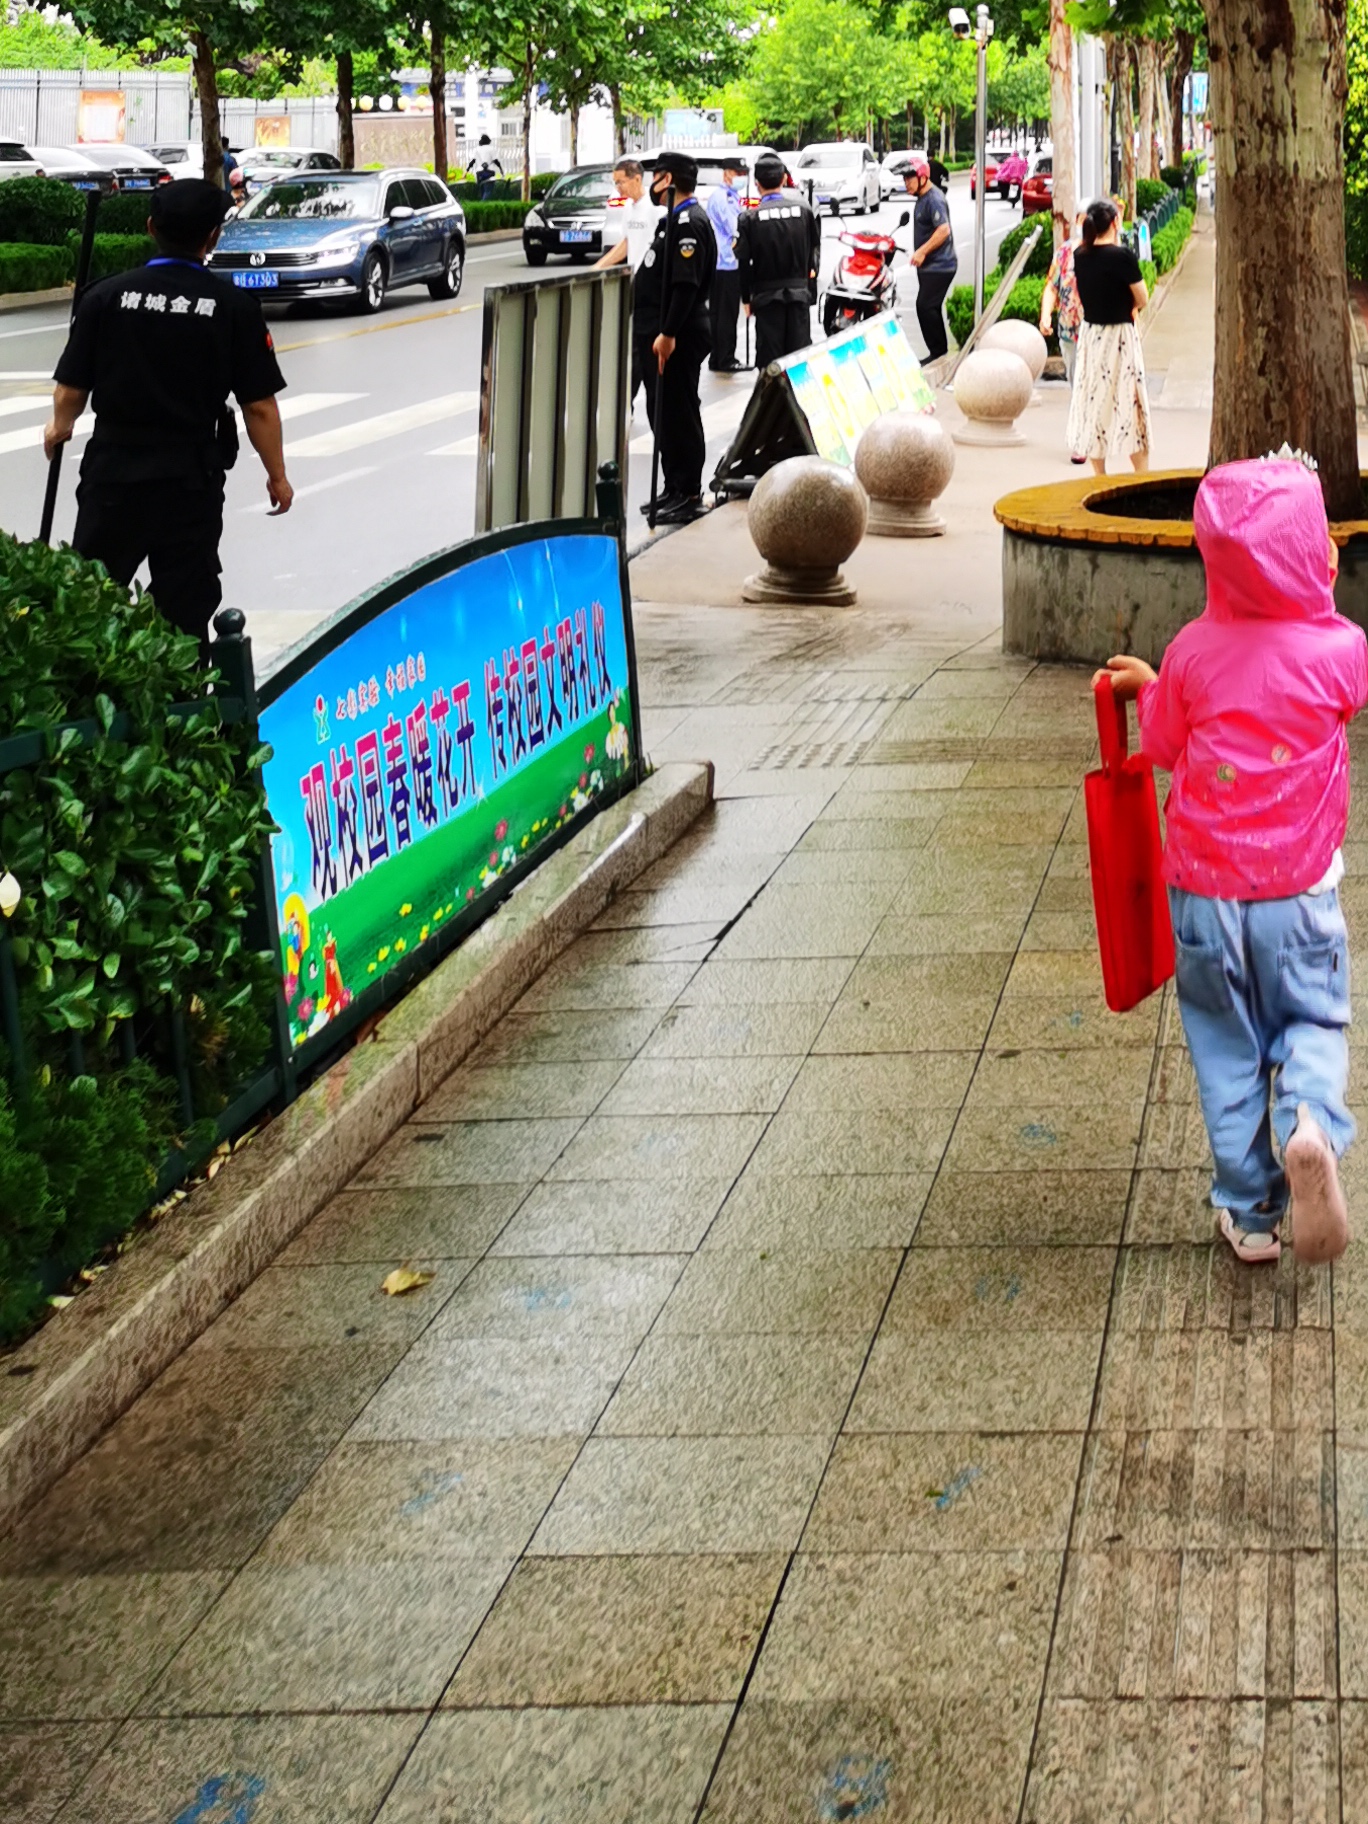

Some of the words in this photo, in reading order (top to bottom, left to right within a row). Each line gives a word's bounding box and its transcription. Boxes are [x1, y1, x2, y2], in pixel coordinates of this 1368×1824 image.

[120, 290, 217, 317] 诸城金盾
[300, 679, 478, 903] 观校园春暖花开
[483, 600, 613, 780] 传校园文明礼仪
